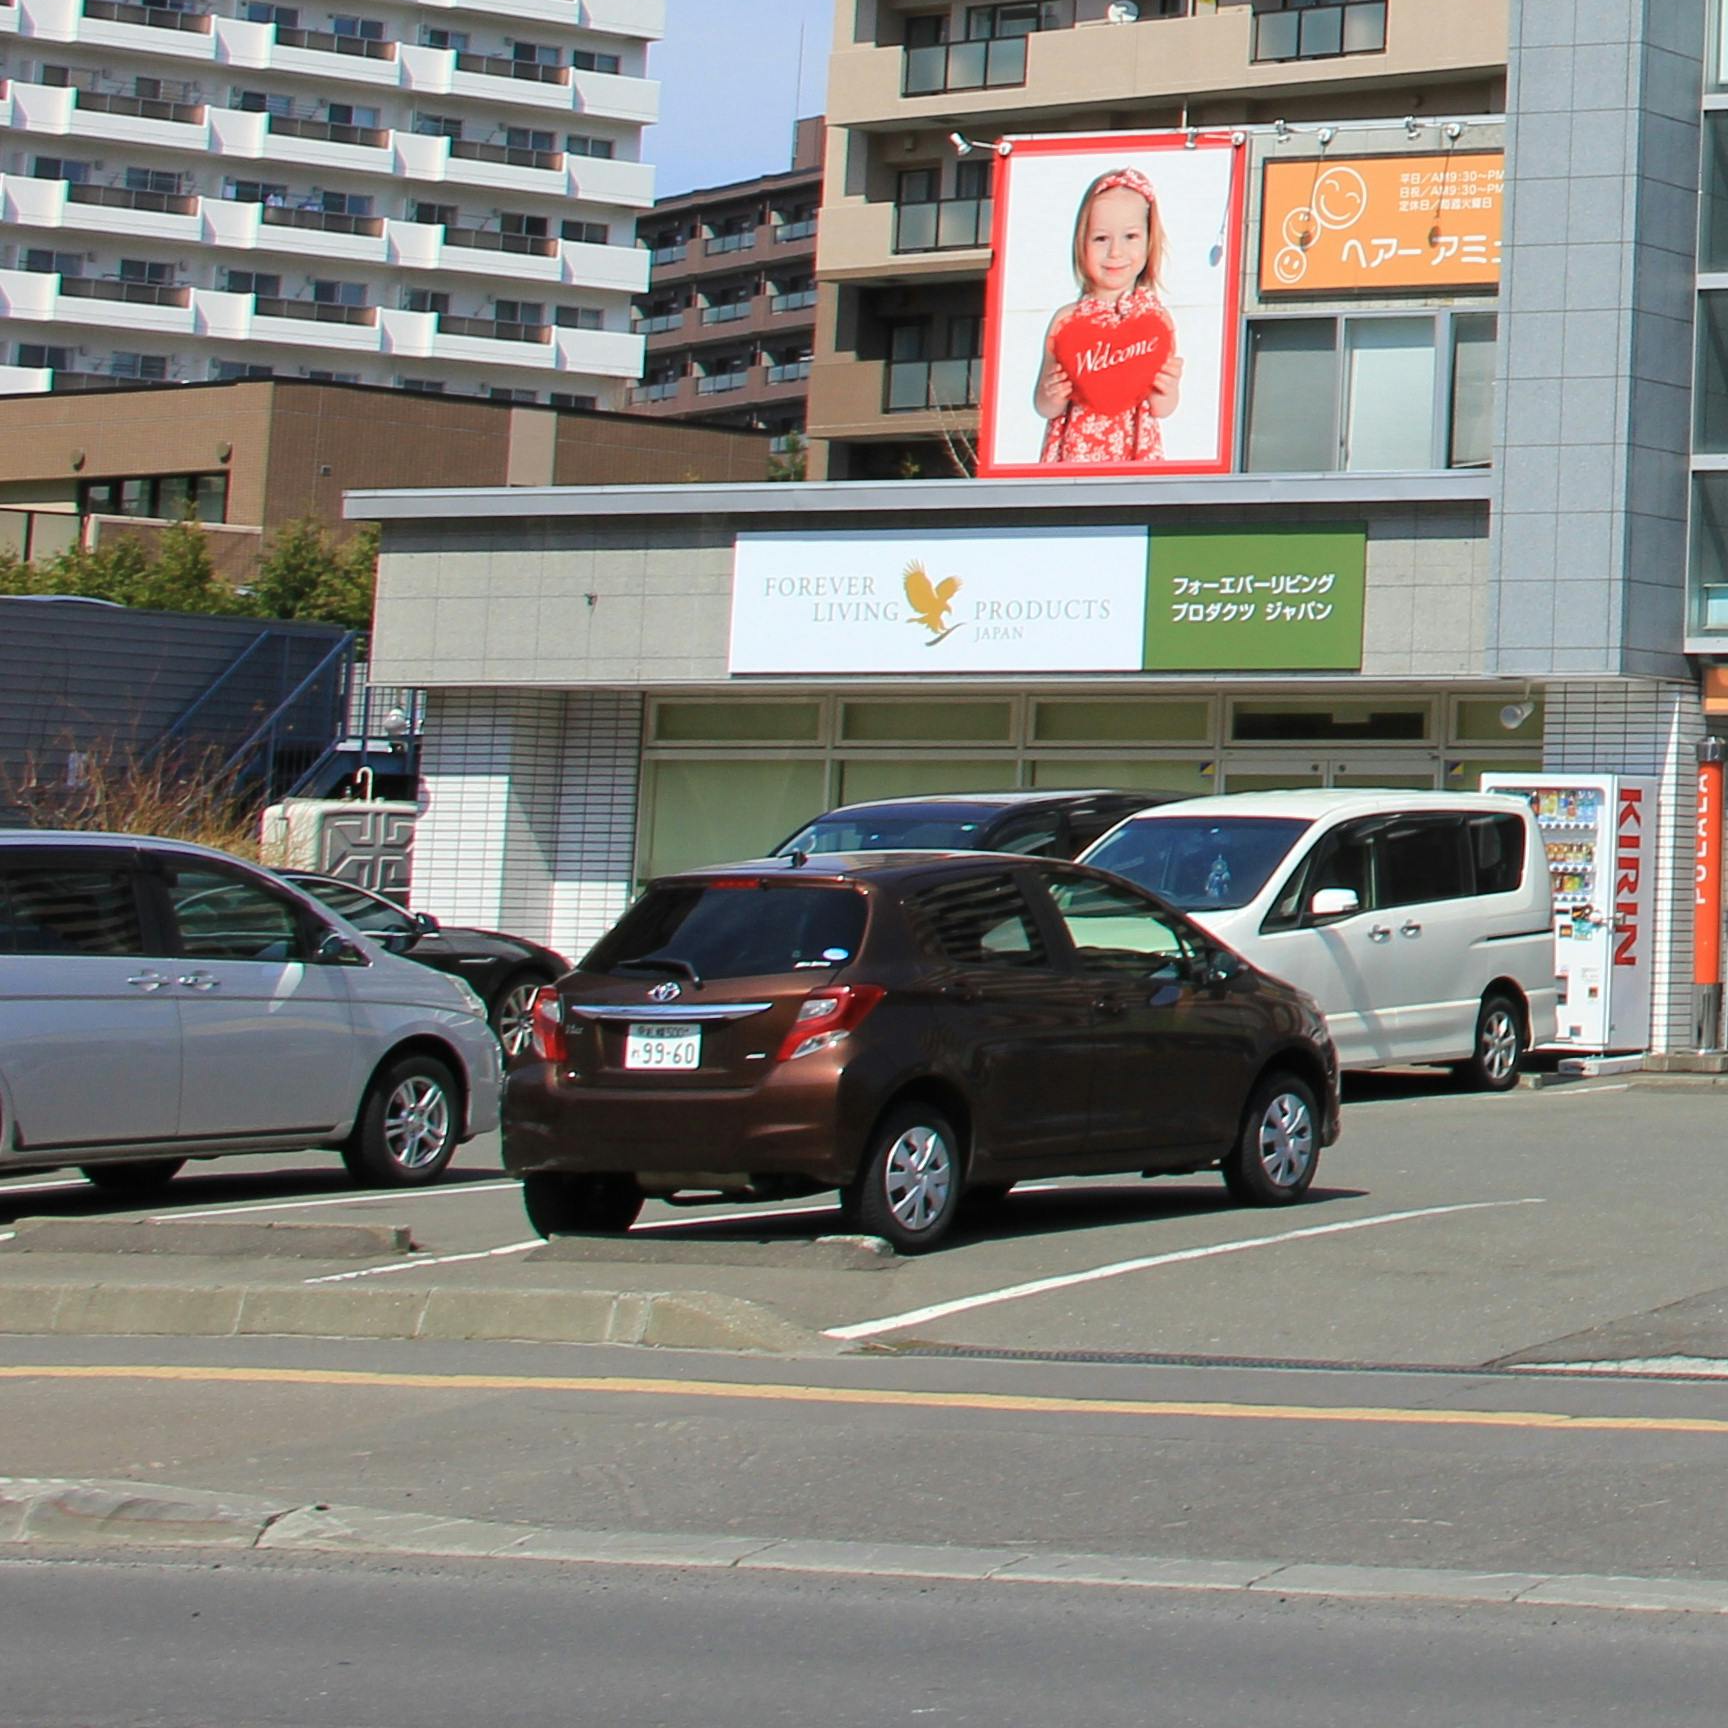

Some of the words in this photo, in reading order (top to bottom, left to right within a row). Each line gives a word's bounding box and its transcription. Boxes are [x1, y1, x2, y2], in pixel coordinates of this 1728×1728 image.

[1341, 235, 1423, 269] ヘアー
[1074, 333, 1159, 378] Welcome
[764, 575, 876, 597] FOREVER
[1172, 573, 1336, 595] フォーエバーリビング
[812, 599, 900, 623] LIVING
[974, 599, 1112, 621] PRODUCTS
[1171, 600, 1256, 622] プロダクツ
[1265, 600, 1333, 622] ジャパン
[973, 626, 1025, 642] JAPAN
[1614, 787, 1643, 967] KIRIN
[643, 1042, 695, 1065] 99-60
